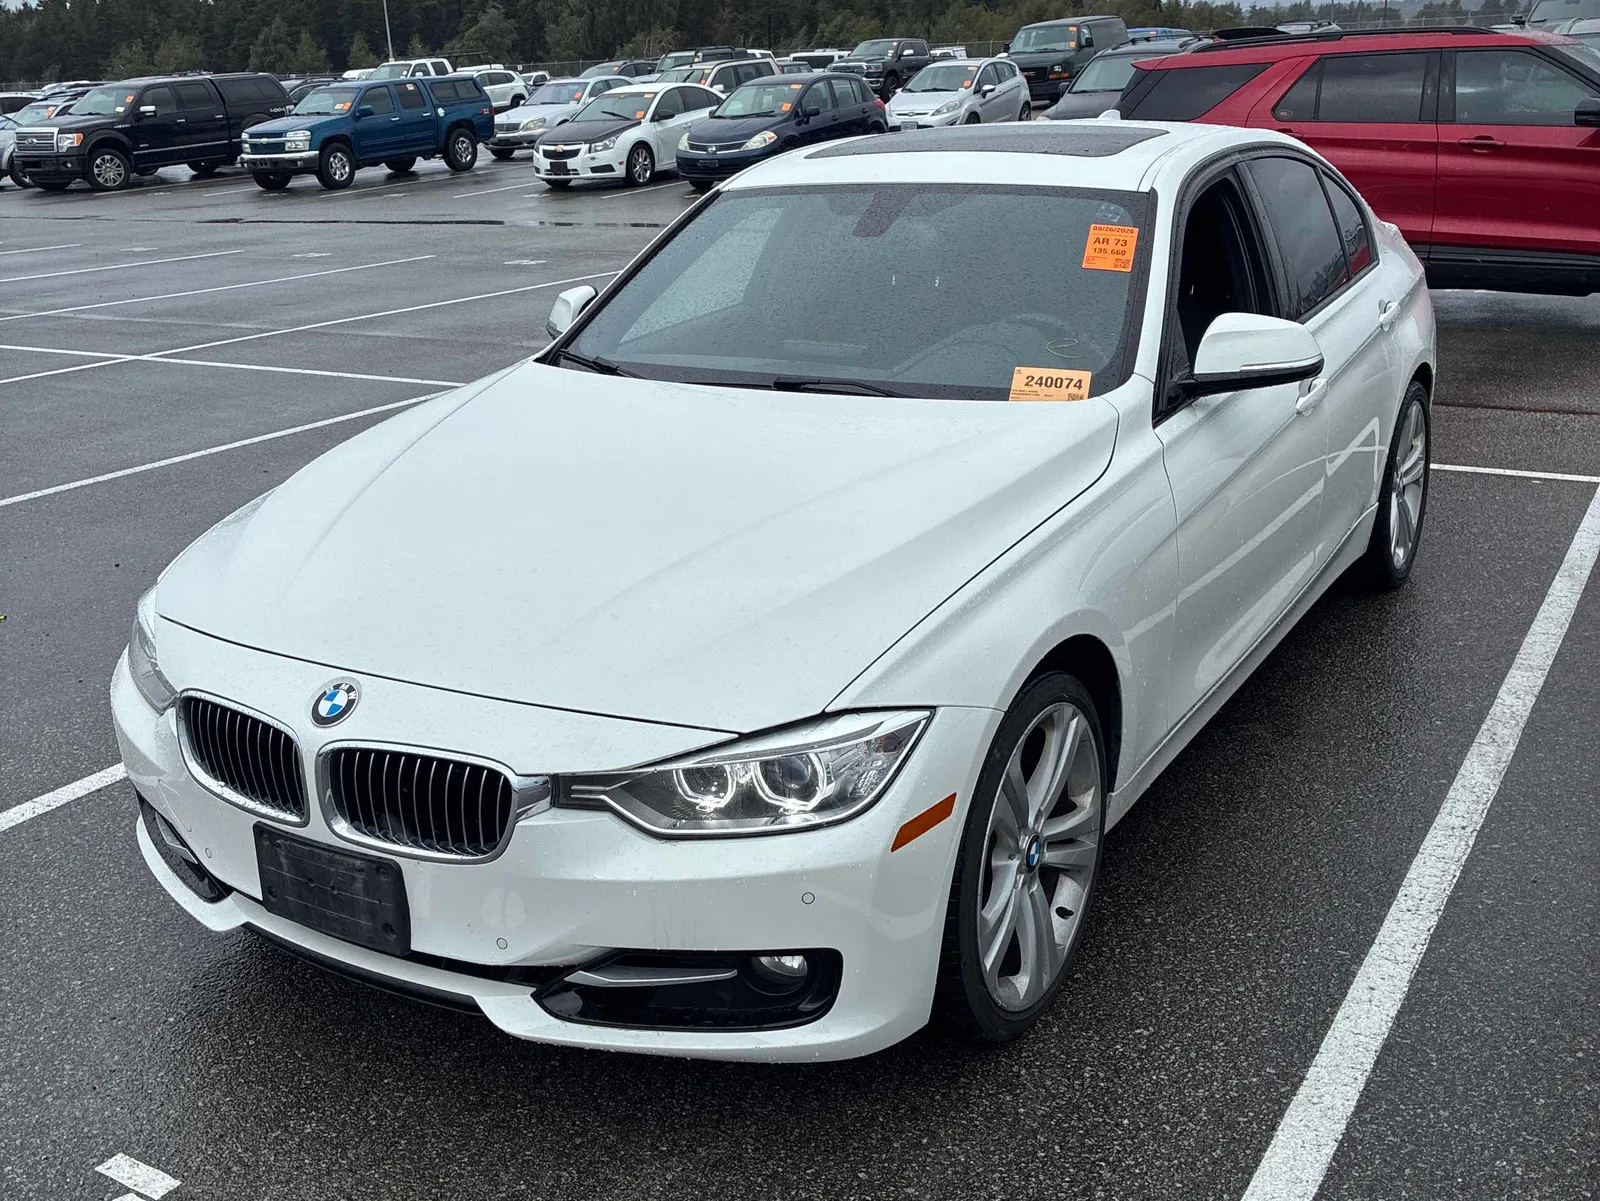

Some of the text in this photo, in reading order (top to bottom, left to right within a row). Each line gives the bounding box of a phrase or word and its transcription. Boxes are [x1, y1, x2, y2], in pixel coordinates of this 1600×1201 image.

[1093, 237, 1128, 247] AR 73
[1024, 375, 1083, 390] 240074
[325, 683, 357, 700] BMW
